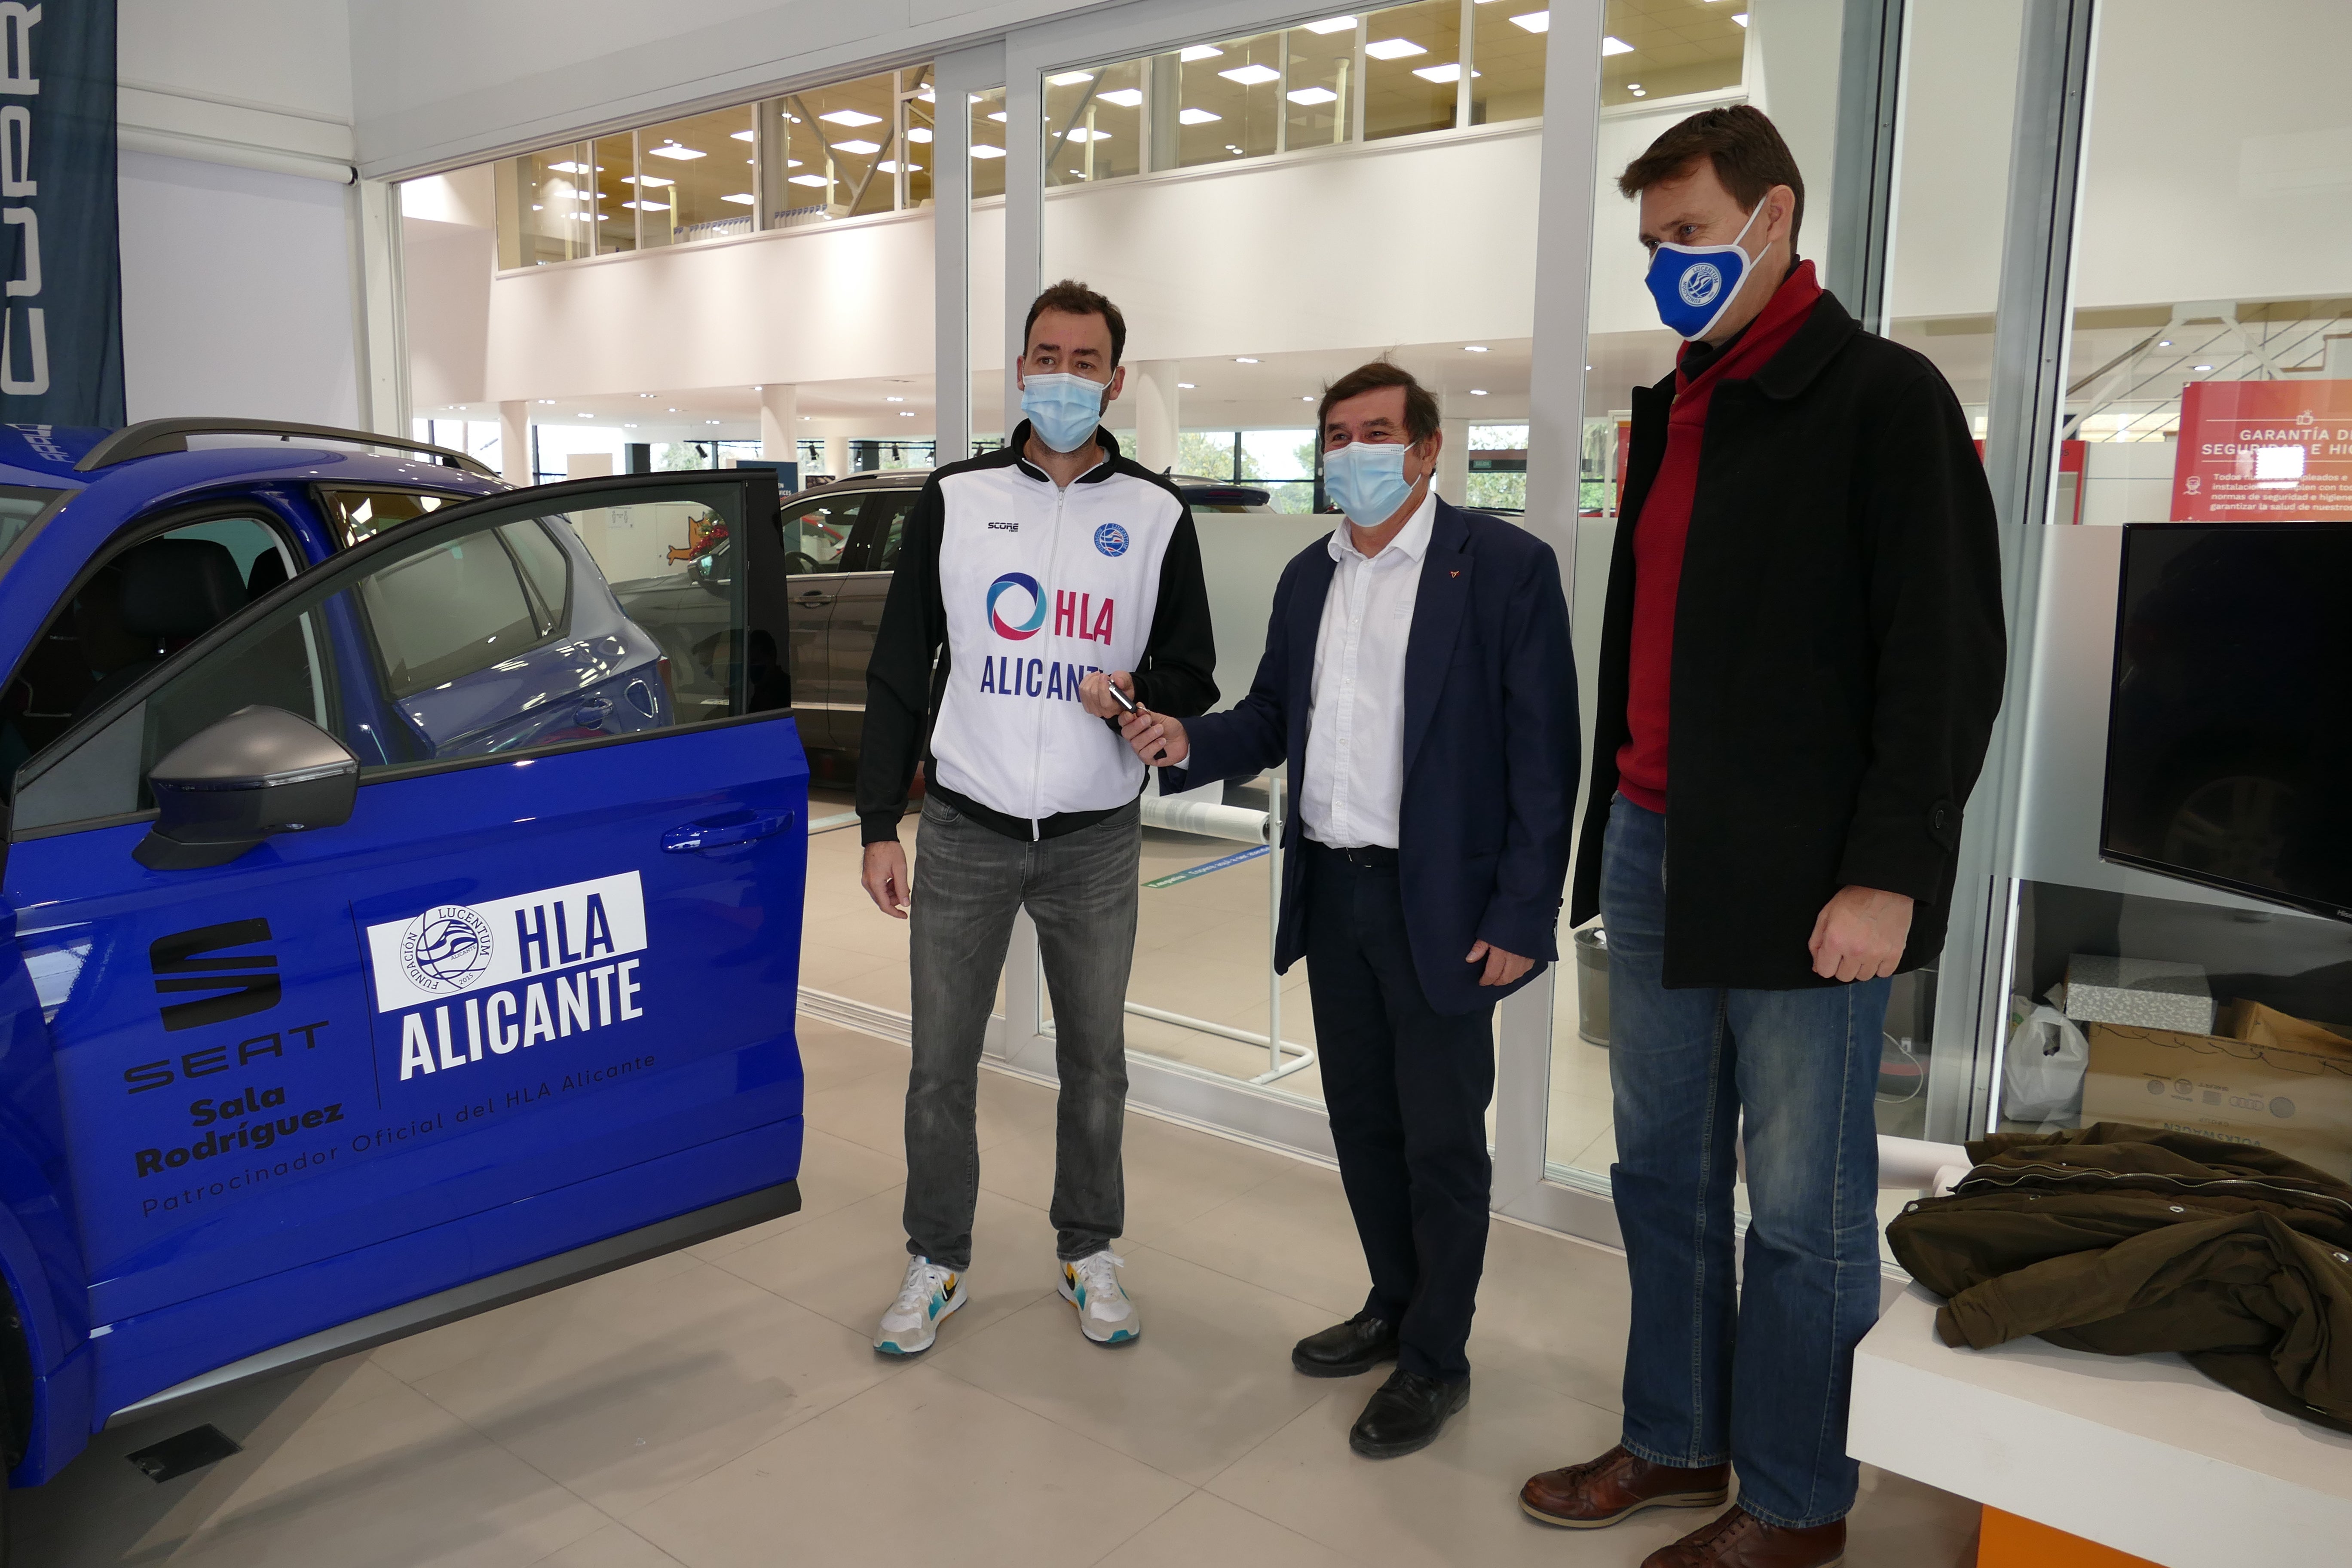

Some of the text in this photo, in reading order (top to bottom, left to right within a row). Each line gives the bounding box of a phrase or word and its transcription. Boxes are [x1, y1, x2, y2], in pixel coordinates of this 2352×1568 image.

[1692, 266, 1718, 284] LUCENTUM
[2239, 426, 2352, 441] GARANTÍA D
[2311, 444, 2322, 455] E
[2209, 503, 2257, 511] garantizar
[2263, 493, 2309, 502] seguridad
[2319, 493, 2352, 502] higiene
[1112, 524, 1129, 549] LUCENTUM
[1054, 589, 1115, 646] HLA
[980, 655, 1103, 703] ALICAN
[438, 908, 491, 956] LUCENTUM
[450, 945, 476, 961] ALICANTE
[515, 892, 615, 974] HLA
[402, 931, 439, 990] FUNDACIÓN
[459, 973, 474, 985] 2015
[399, 958, 643, 1081] ALICANTE
[123, 1020, 330, 1095] SEAT
[188, 1086, 286, 1127] Sala
[135, 1102, 345, 1178] Rodríguez
[142, 1055, 656, 1218] Patrocinador Oficial del HLA Alicante
